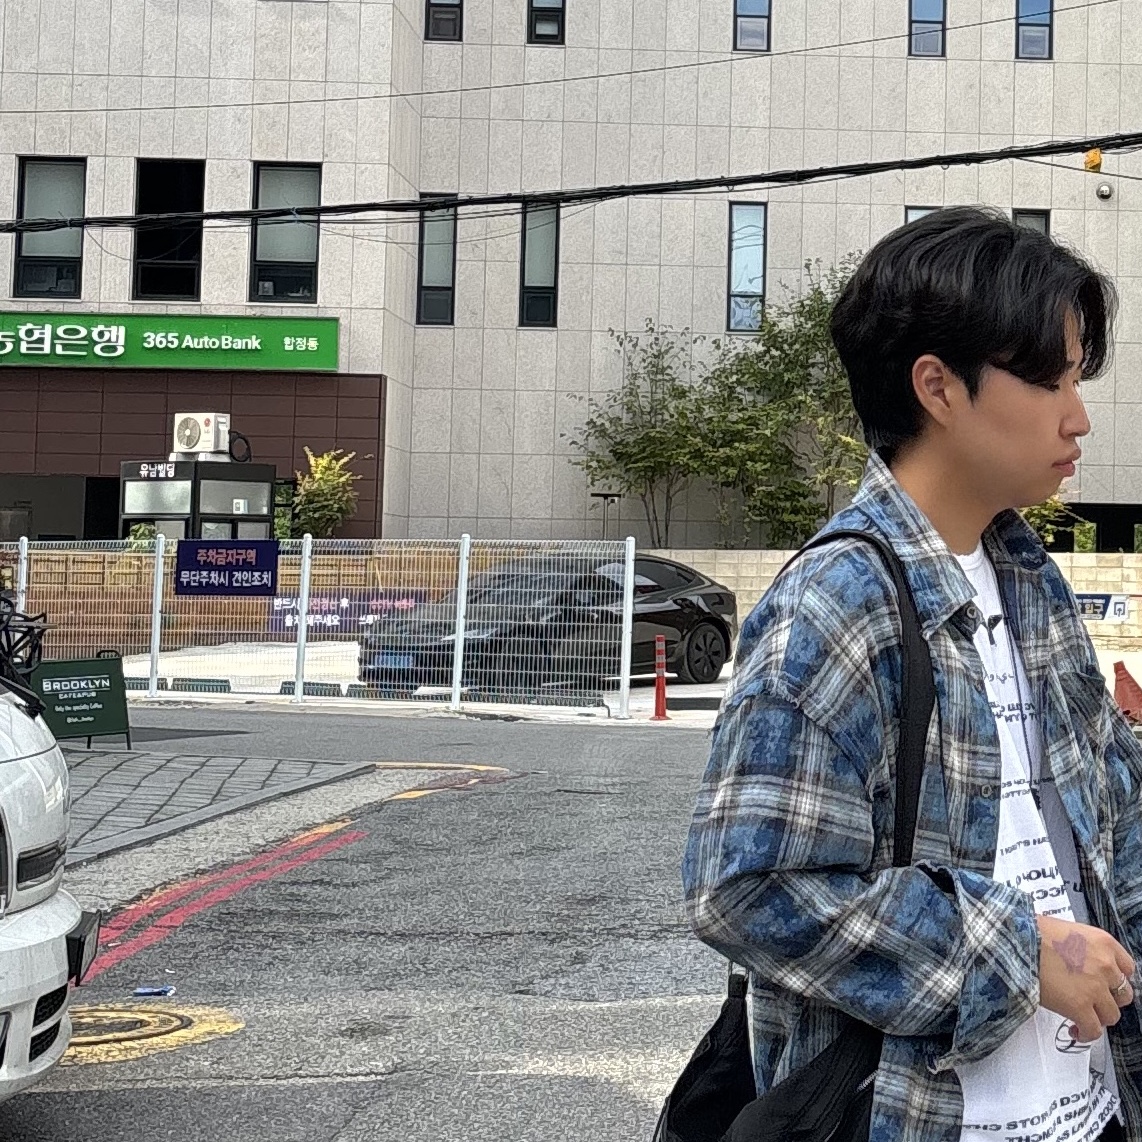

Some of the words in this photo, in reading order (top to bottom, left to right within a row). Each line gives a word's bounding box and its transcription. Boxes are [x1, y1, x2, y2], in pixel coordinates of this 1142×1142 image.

[142, 331, 179, 350] 365
[181, 333, 220, 350] Auto
[221, 335, 262, 351] Bank
[283, 336, 320, 351] 합정동
[196, 548, 257, 566] 주차금지구역
[180, 569, 229, 587] 무단주차시
[231, 570, 272, 588] 견인조치
[42, 678, 110, 691] BROOKLYN
